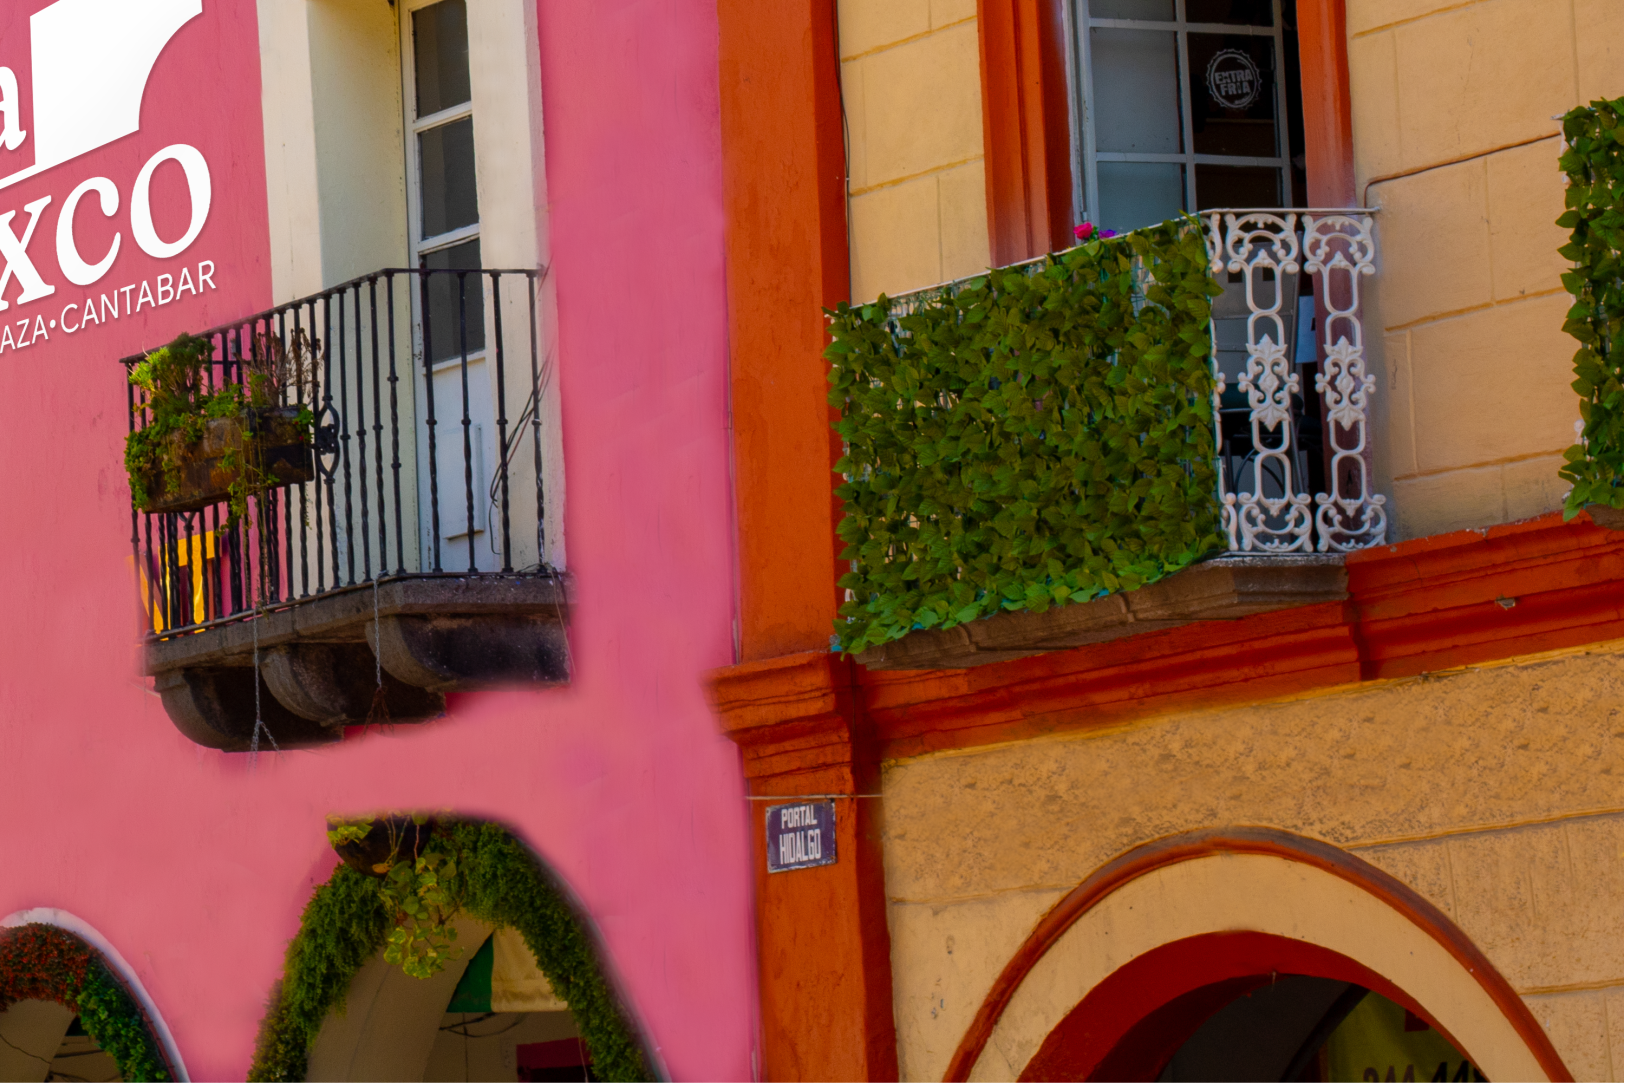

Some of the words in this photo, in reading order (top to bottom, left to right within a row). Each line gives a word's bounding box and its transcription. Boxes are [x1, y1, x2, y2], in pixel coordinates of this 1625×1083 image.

[1215, 70, 1253, 84] EXTRA
[60, 259, 218, 335] CANTABAR
[781, 805, 817, 829] PORTAL
[779, 828, 821, 864] HIDALGO
